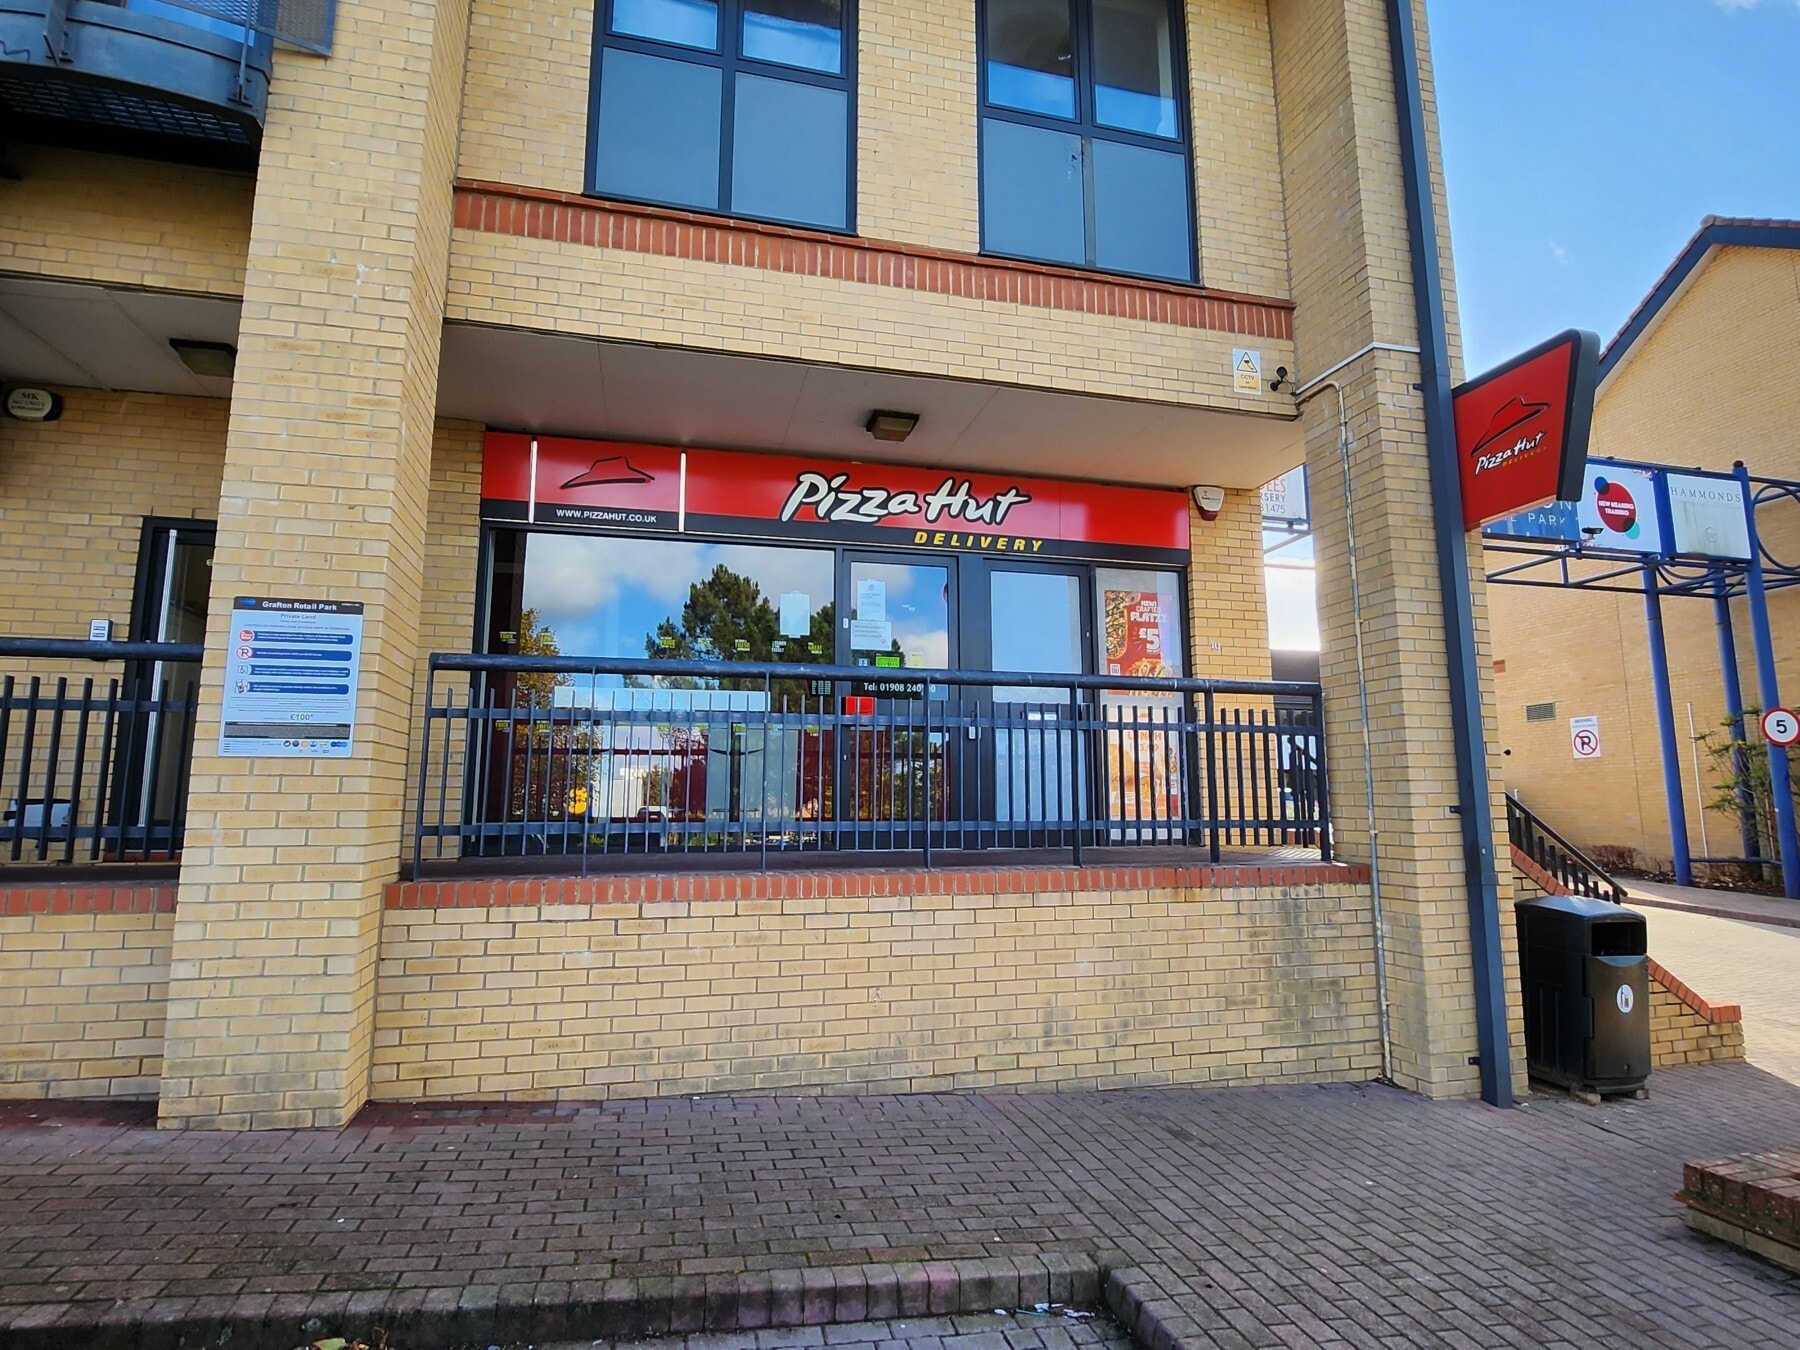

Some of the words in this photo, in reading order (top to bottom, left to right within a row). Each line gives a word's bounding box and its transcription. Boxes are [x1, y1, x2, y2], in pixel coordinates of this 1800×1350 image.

[22, 392, 40, 400] MK
[1475, 449, 1513, 475] Pizza
[1513, 431, 1546, 456] Hut
[780, 473, 920, 523] Pizza
[925, 478, 1031, 525] Hut
[1670, 486, 1741, 503] HAMMONDS
[556, 509, 657, 523] WWW.PIZZAHUT.CO.UK
[914, 531, 1044, 552] DELIVERY
[262, 601, 292, 609] Grafton
[293, 602, 316, 610] Retail
[318, 603, 338, 611] Park
[1138, 627, 1161, 650] £5
[863, 682, 878, 691] Tel:
[879, 682, 905, 692] 01908
[906, 682, 936, 693] 2400
[1775, 719, 1788, 734] 5
